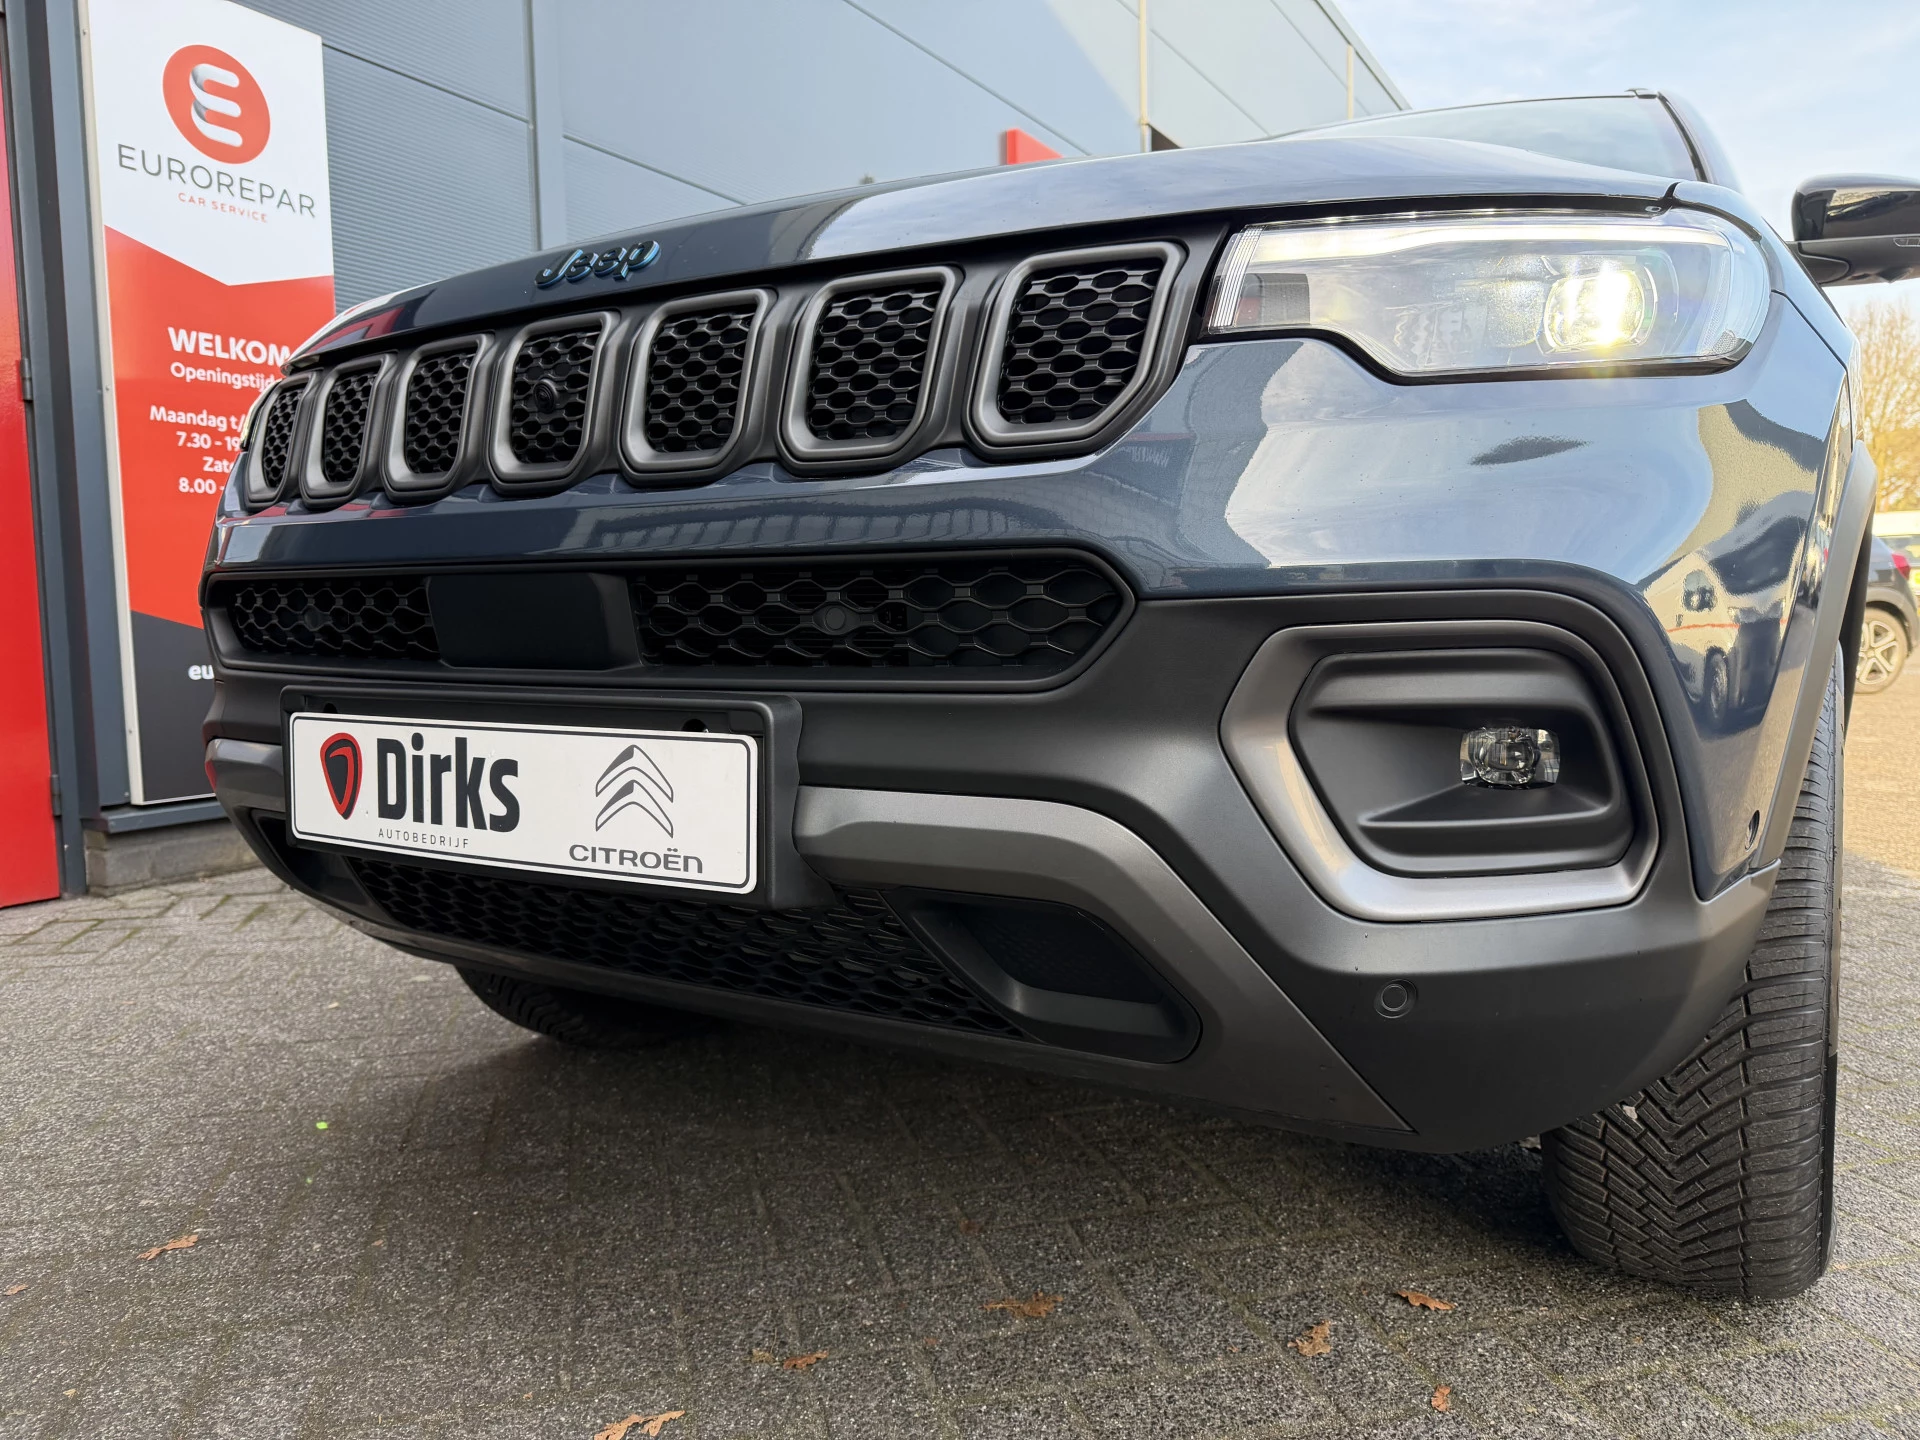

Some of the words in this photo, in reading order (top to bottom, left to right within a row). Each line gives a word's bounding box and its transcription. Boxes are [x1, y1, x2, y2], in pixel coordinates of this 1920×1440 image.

[117, 143, 316, 218] EUROREPAR
[177, 192, 206, 207] CAR
[211, 201, 268, 223] SERVICE
[534, 240, 660, 290] Jeep
[168, 327, 290, 367] WELKOM
[149, 405, 227, 432] Maandag
[176, 431, 212, 449] 7.30
[178, 477, 217, 494] 8.00
[376, 732, 521, 834] Dirks
[377, 827, 470, 850] AUTOBEDRIJF
